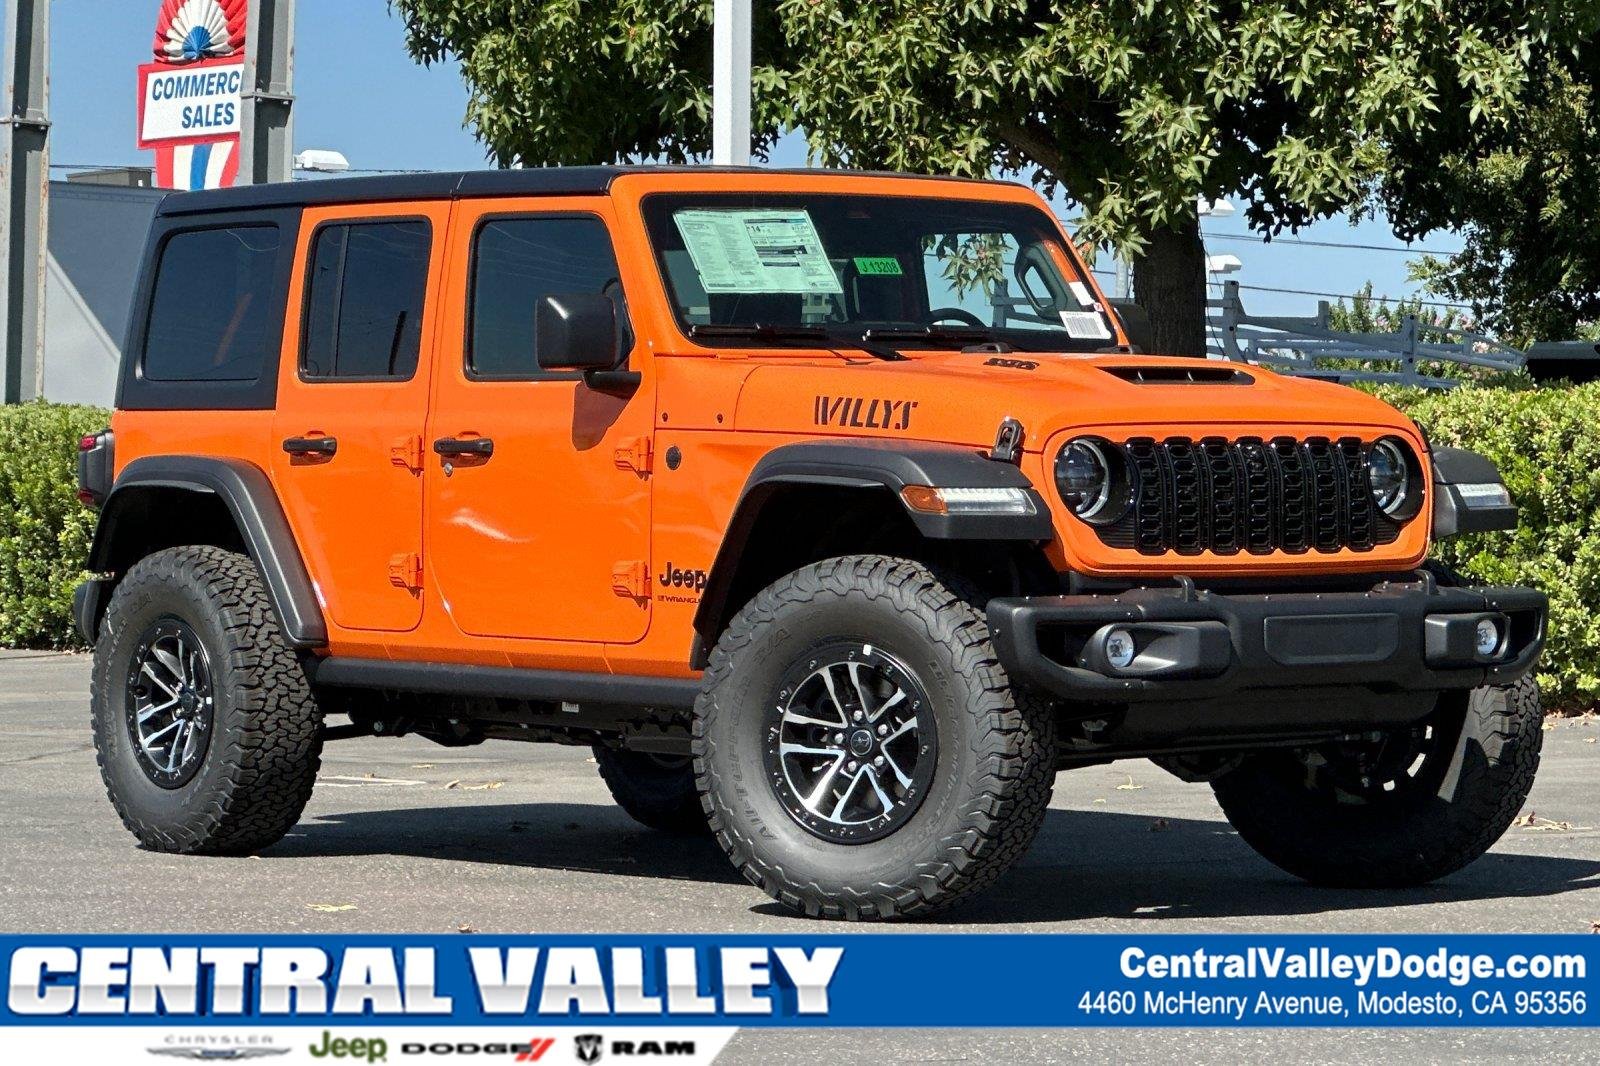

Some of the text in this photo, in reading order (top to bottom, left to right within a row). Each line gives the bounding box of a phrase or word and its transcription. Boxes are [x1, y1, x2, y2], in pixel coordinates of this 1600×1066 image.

[181, 103, 235, 129] SALES
[869, 261, 899, 273] 13208
[814, 395, 919, 430] WILLYS
[659, 562, 707, 593] Jeep
[665, 595, 700, 604] WRANGL
